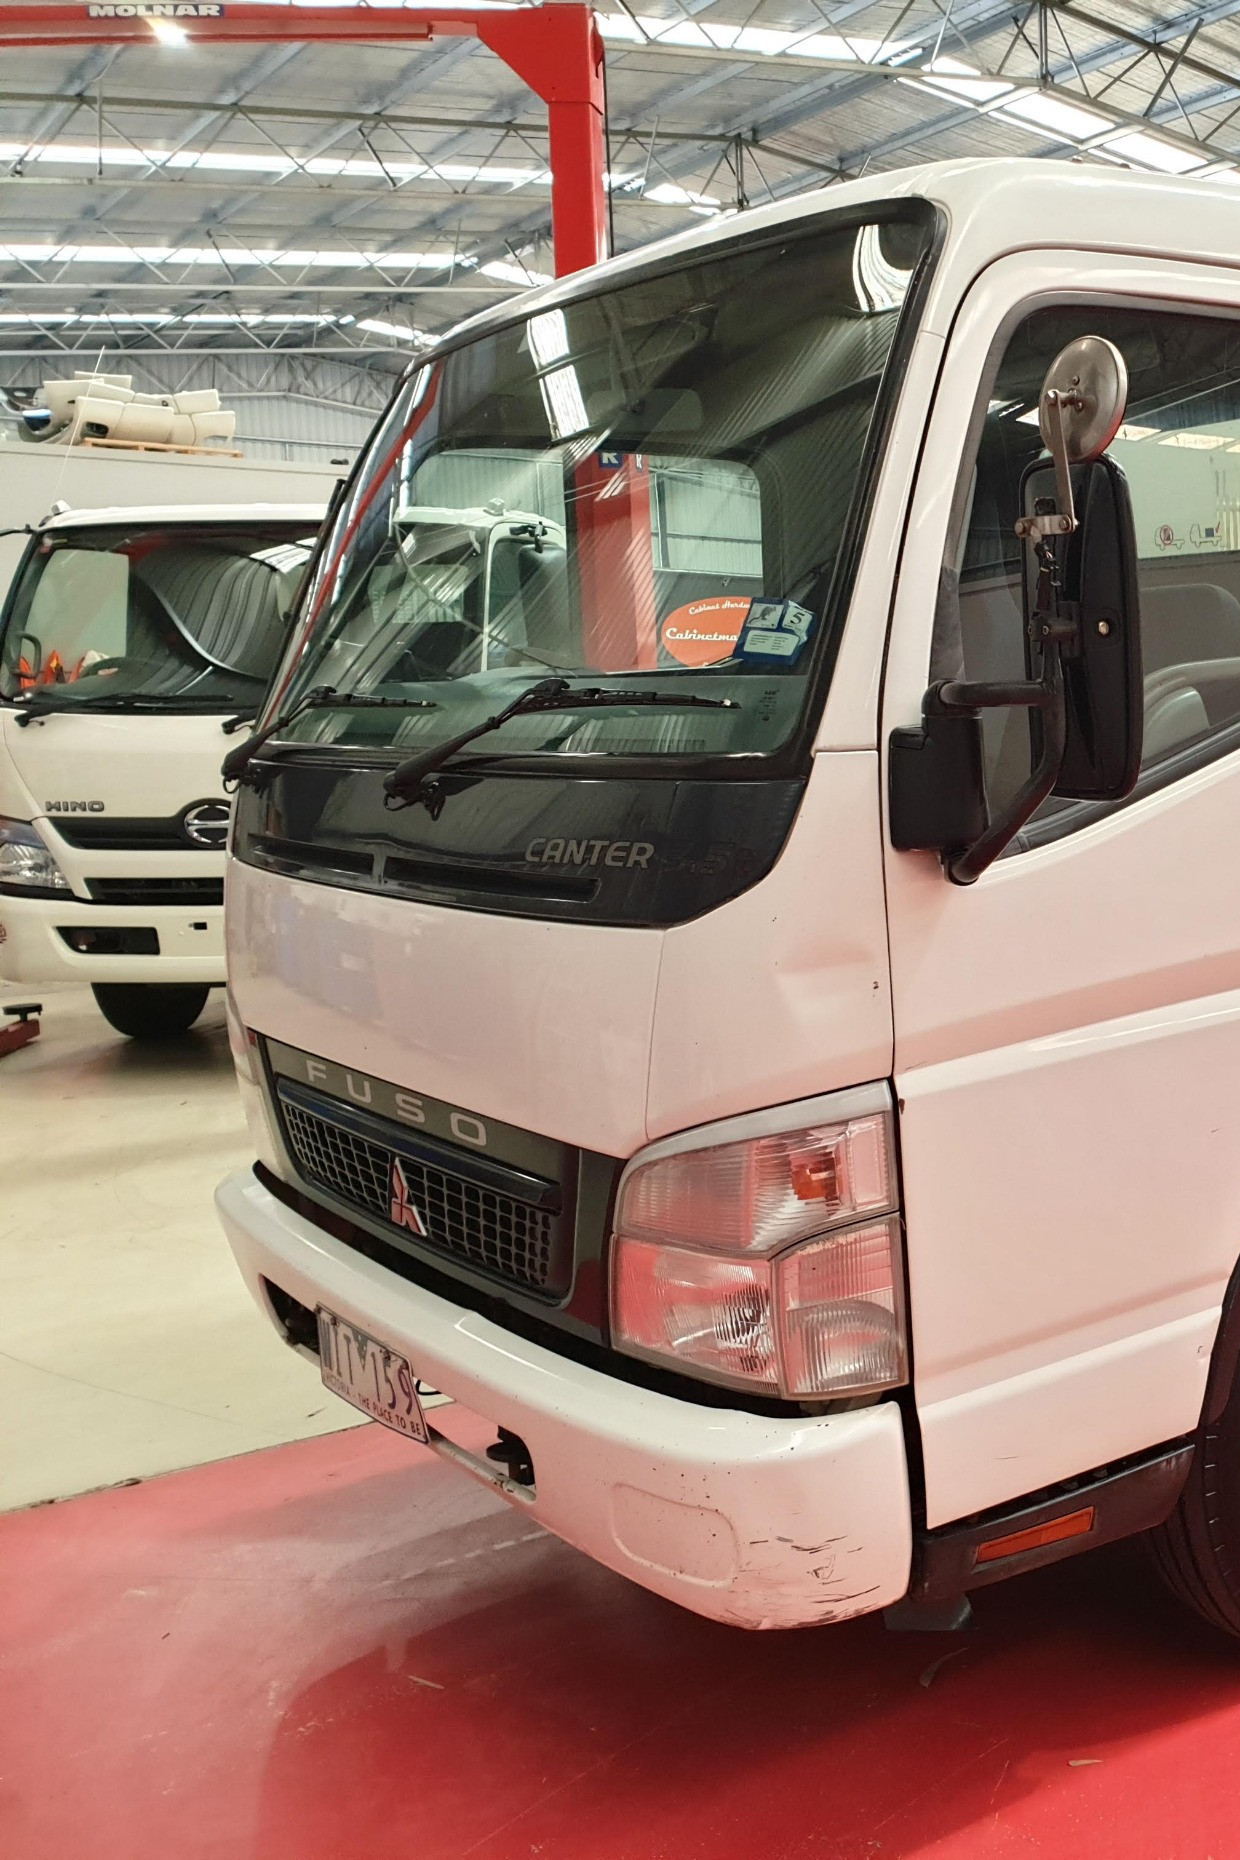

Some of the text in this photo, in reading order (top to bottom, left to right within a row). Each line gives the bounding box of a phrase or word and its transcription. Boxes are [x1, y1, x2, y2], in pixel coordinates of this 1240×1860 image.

[88, 4, 221, 17] MOLNAR
[688, 603, 720, 615] Cabinet
[789, 612, 805, 625] 5
[45, 800, 105, 813] HINO
[525, 837, 655, 869] CANTER
[305, 1059, 487, 1147] FUSO
[372, 1401, 394, 1425] PLACE
[395, 1414, 407, 1430] TO
[410, 1421, 421, 1436] BE
